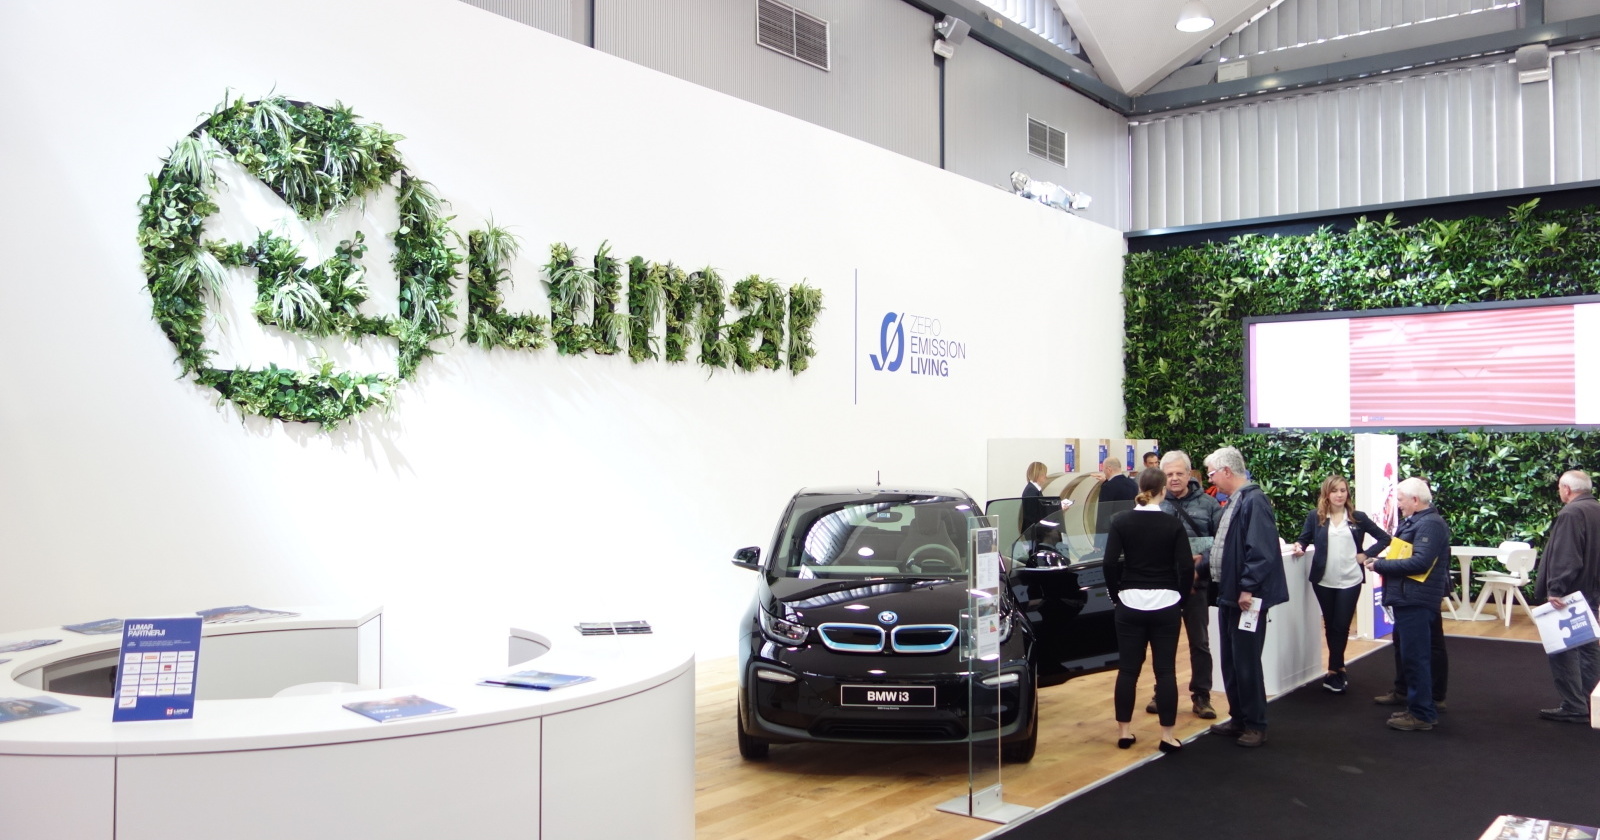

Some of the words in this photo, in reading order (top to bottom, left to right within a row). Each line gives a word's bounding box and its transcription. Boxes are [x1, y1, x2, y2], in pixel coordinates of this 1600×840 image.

[910, 314, 941, 336] ZERO
[910, 335, 966, 359] EMISSION
[910, 356, 949, 377] LIVING
[128, 629, 165, 637] PARTNERJI
[867, 690, 897, 702] BMW
[898, 691, 910, 702] i3
